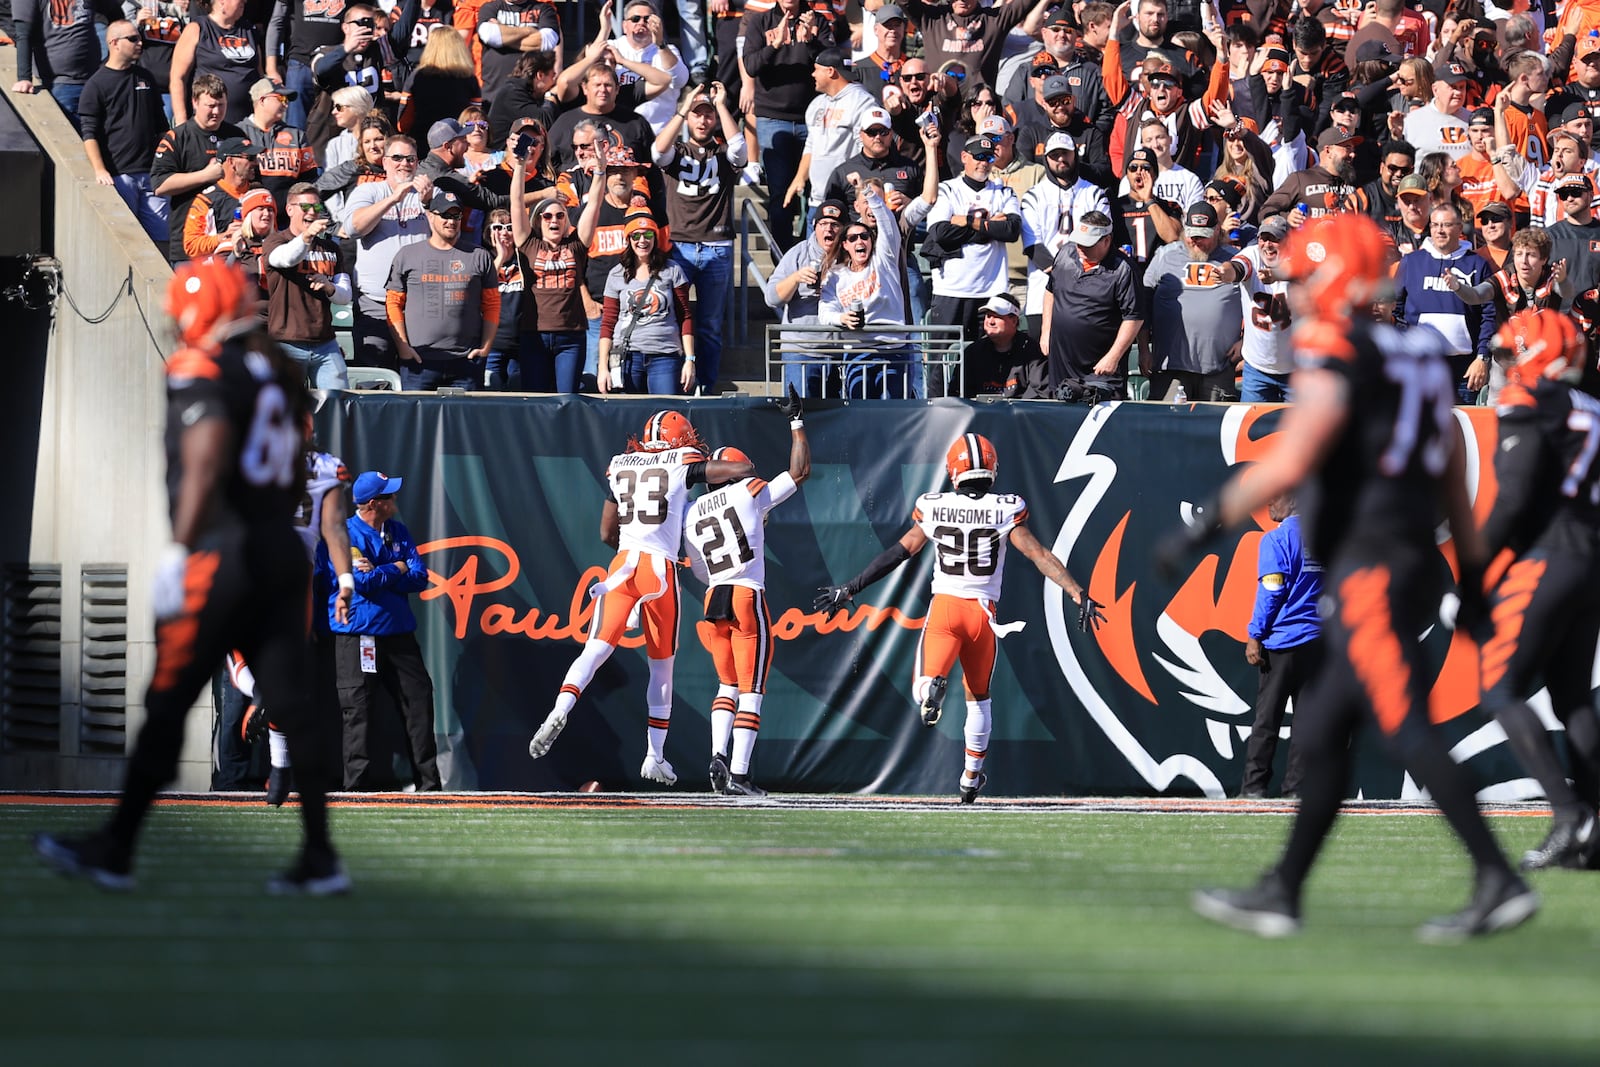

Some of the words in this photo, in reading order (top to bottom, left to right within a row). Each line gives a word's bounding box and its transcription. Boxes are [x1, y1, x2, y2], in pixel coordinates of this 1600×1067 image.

[410, 22, 445, 47] 8
[677, 155, 721, 196] 24
[1132, 217, 1147, 263] 1
[421, 273, 472, 282] BENGALS
[1251, 292, 1292, 332] 24
[613, 454, 661, 466] HARRISON
[663, 451, 678, 464] JR
[616, 468, 669, 525] 33
[697, 492, 728, 516] WARD
[932, 507, 992, 525] NEWSOME
[695, 507, 755, 575] 21
[933, 525, 1001, 576] 20
[416, 536, 642, 649] Paul
